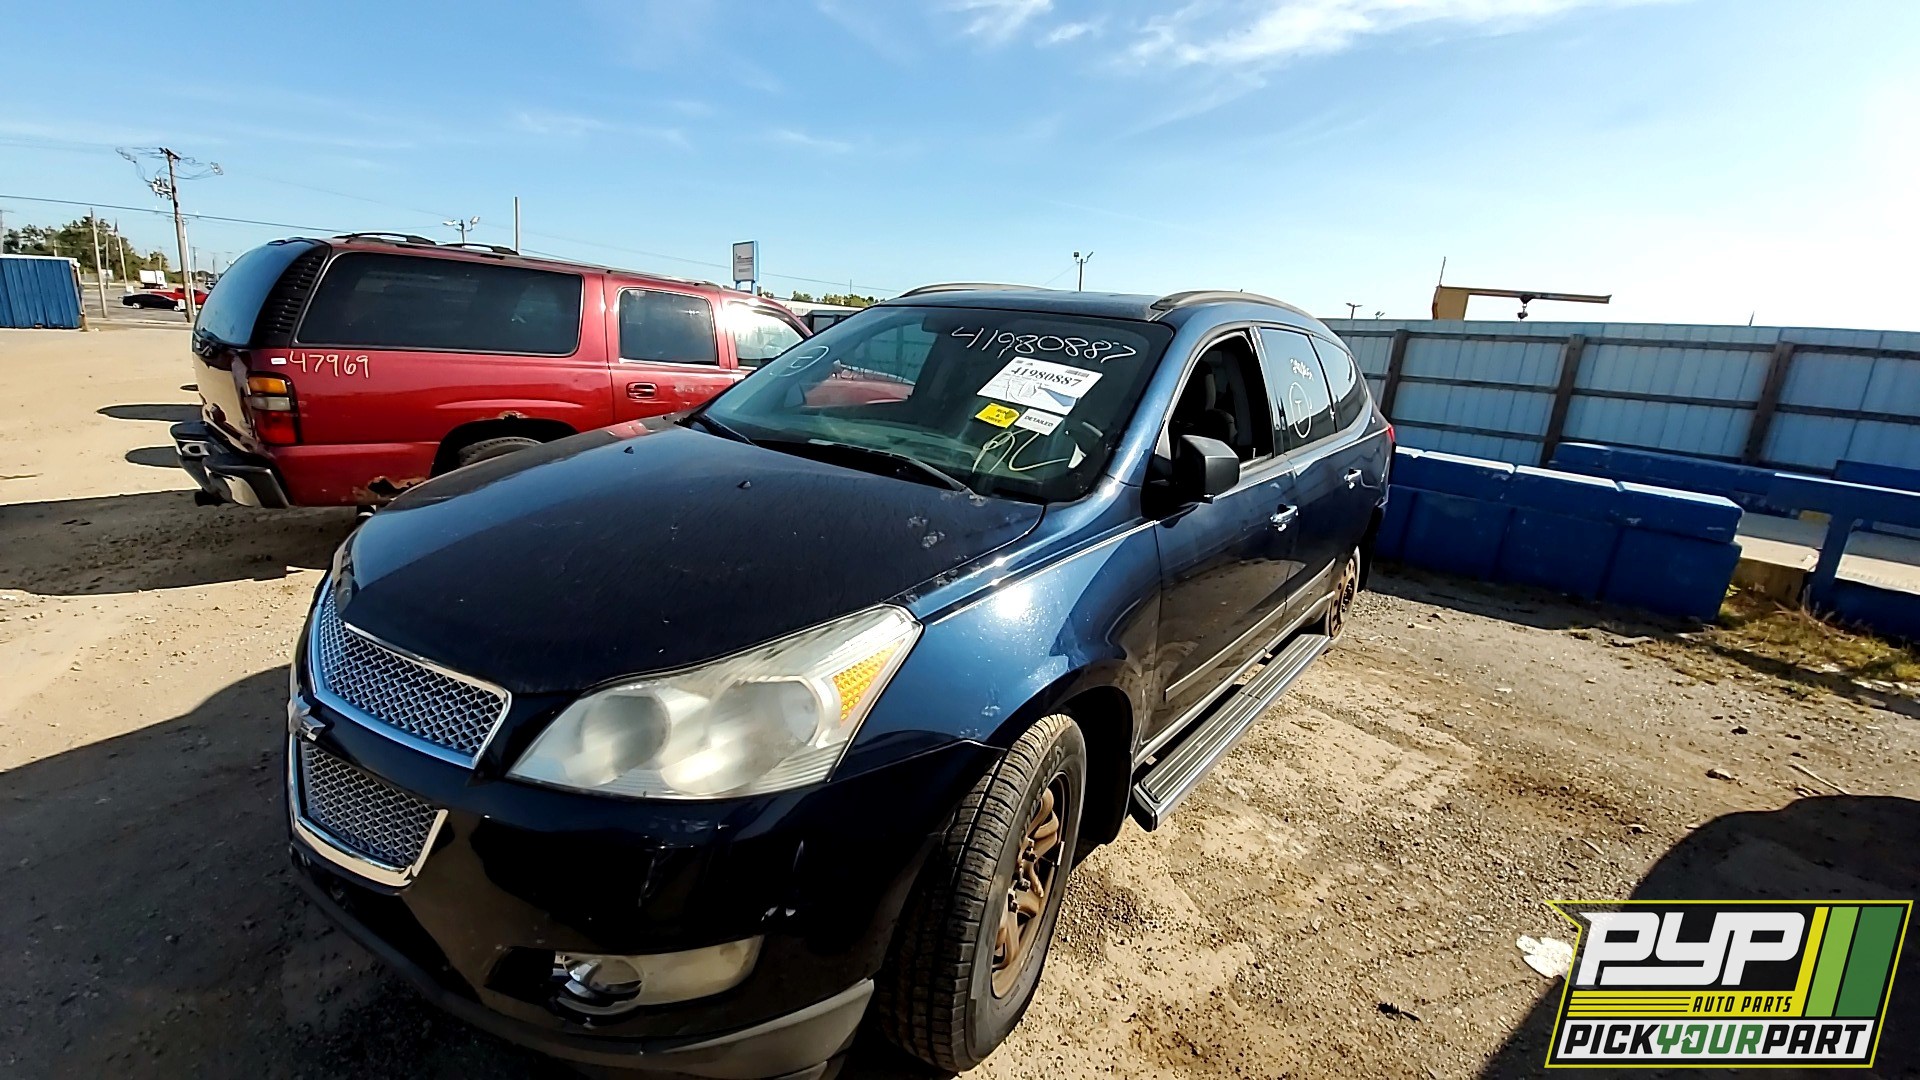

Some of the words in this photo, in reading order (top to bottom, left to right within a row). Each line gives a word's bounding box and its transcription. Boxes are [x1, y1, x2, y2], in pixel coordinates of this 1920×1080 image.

[951, 326, 1137, 364] 41980887
[289, 350, 369, 378] 47969
[1010, 366, 1083, 387] 41980887
[1024, 415, 1054, 427] DETAILED
